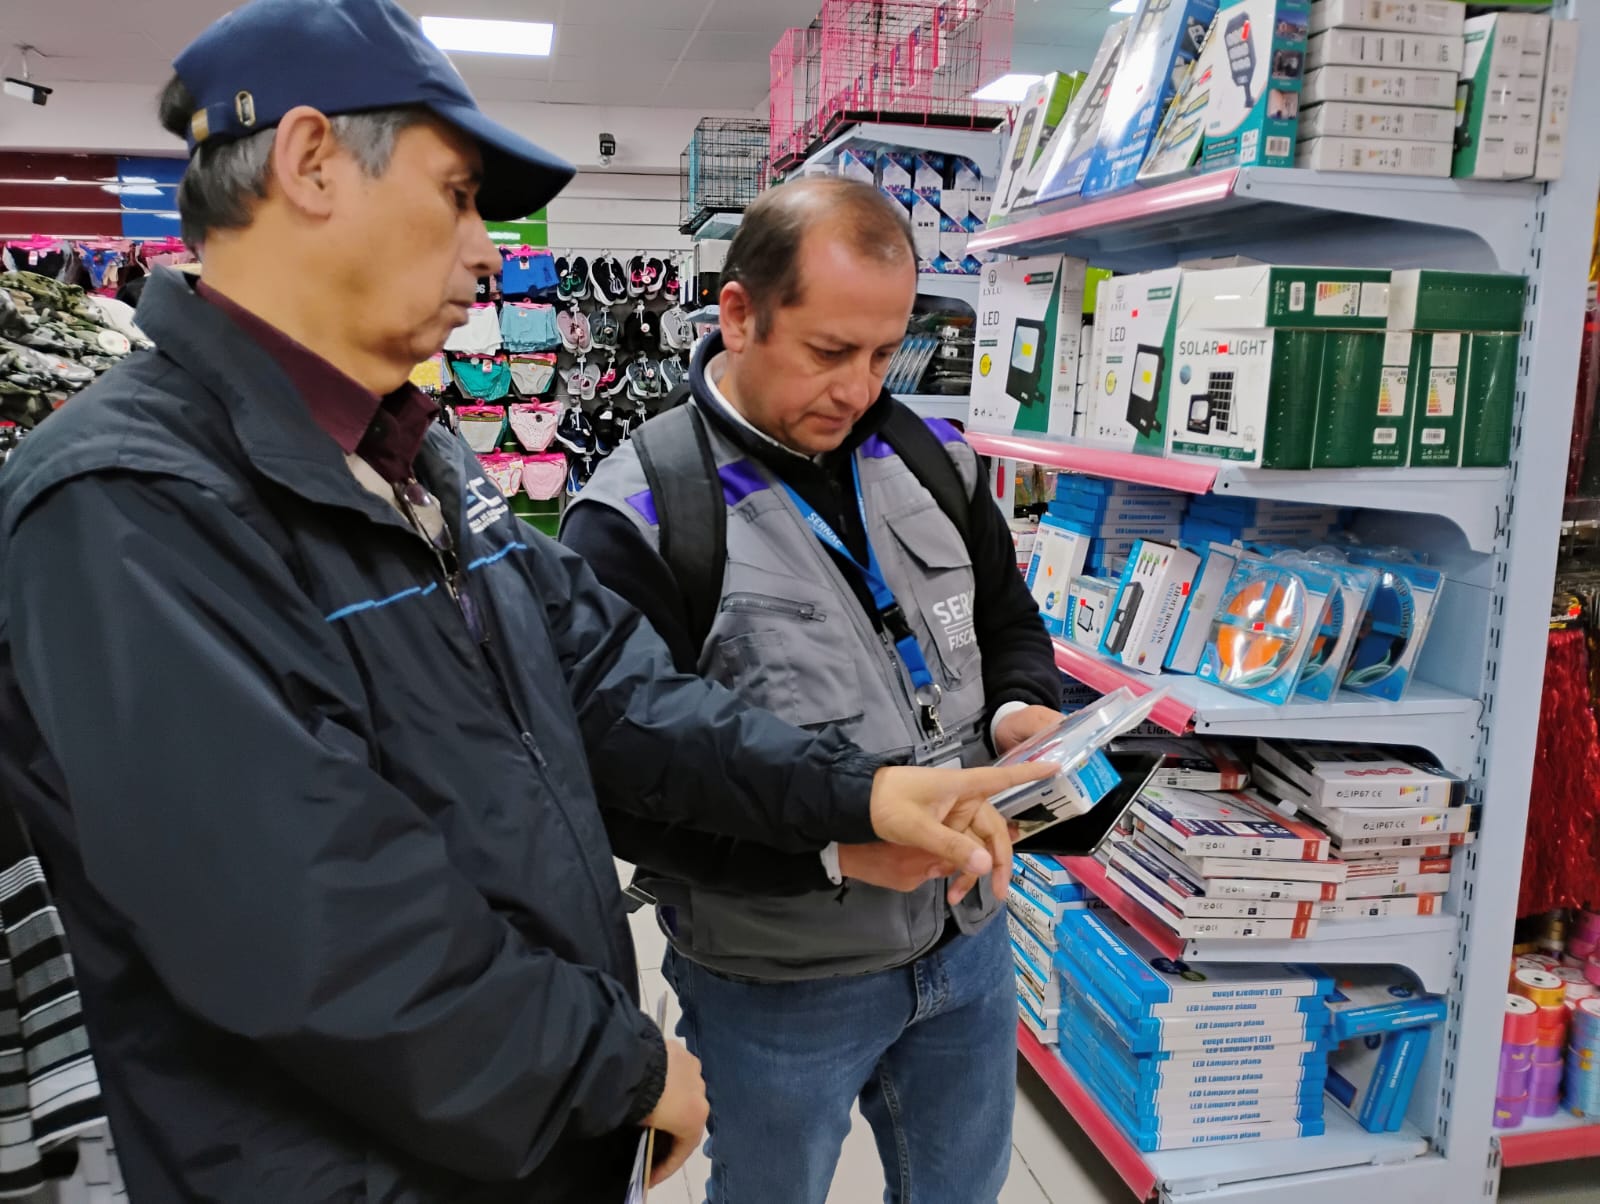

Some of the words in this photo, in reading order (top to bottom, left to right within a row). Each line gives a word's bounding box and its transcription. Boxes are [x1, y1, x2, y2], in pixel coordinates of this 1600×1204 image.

[983, 311, 1000, 326] LED
[1110, 327, 1126, 342] LED
[1179, 340, 1219, 356] SOLAR
[1227, 340, 1267, 356] LIGHT
[933, 590, 974, 624] SER
[1351, 790, 1369, 798] IP67
[1376, 822, 1394, 830] IP67
[1270, 988, 1282, 996] LED
[1186, 1004, 1199, 1012] LED
[1195, 1022, 1208, 1030] LED
[1259, 1035, 1272, 1043] LED
[1189, 1090, 1201, 1098] LED
[1192, 1116, 1205, 1124] LED
